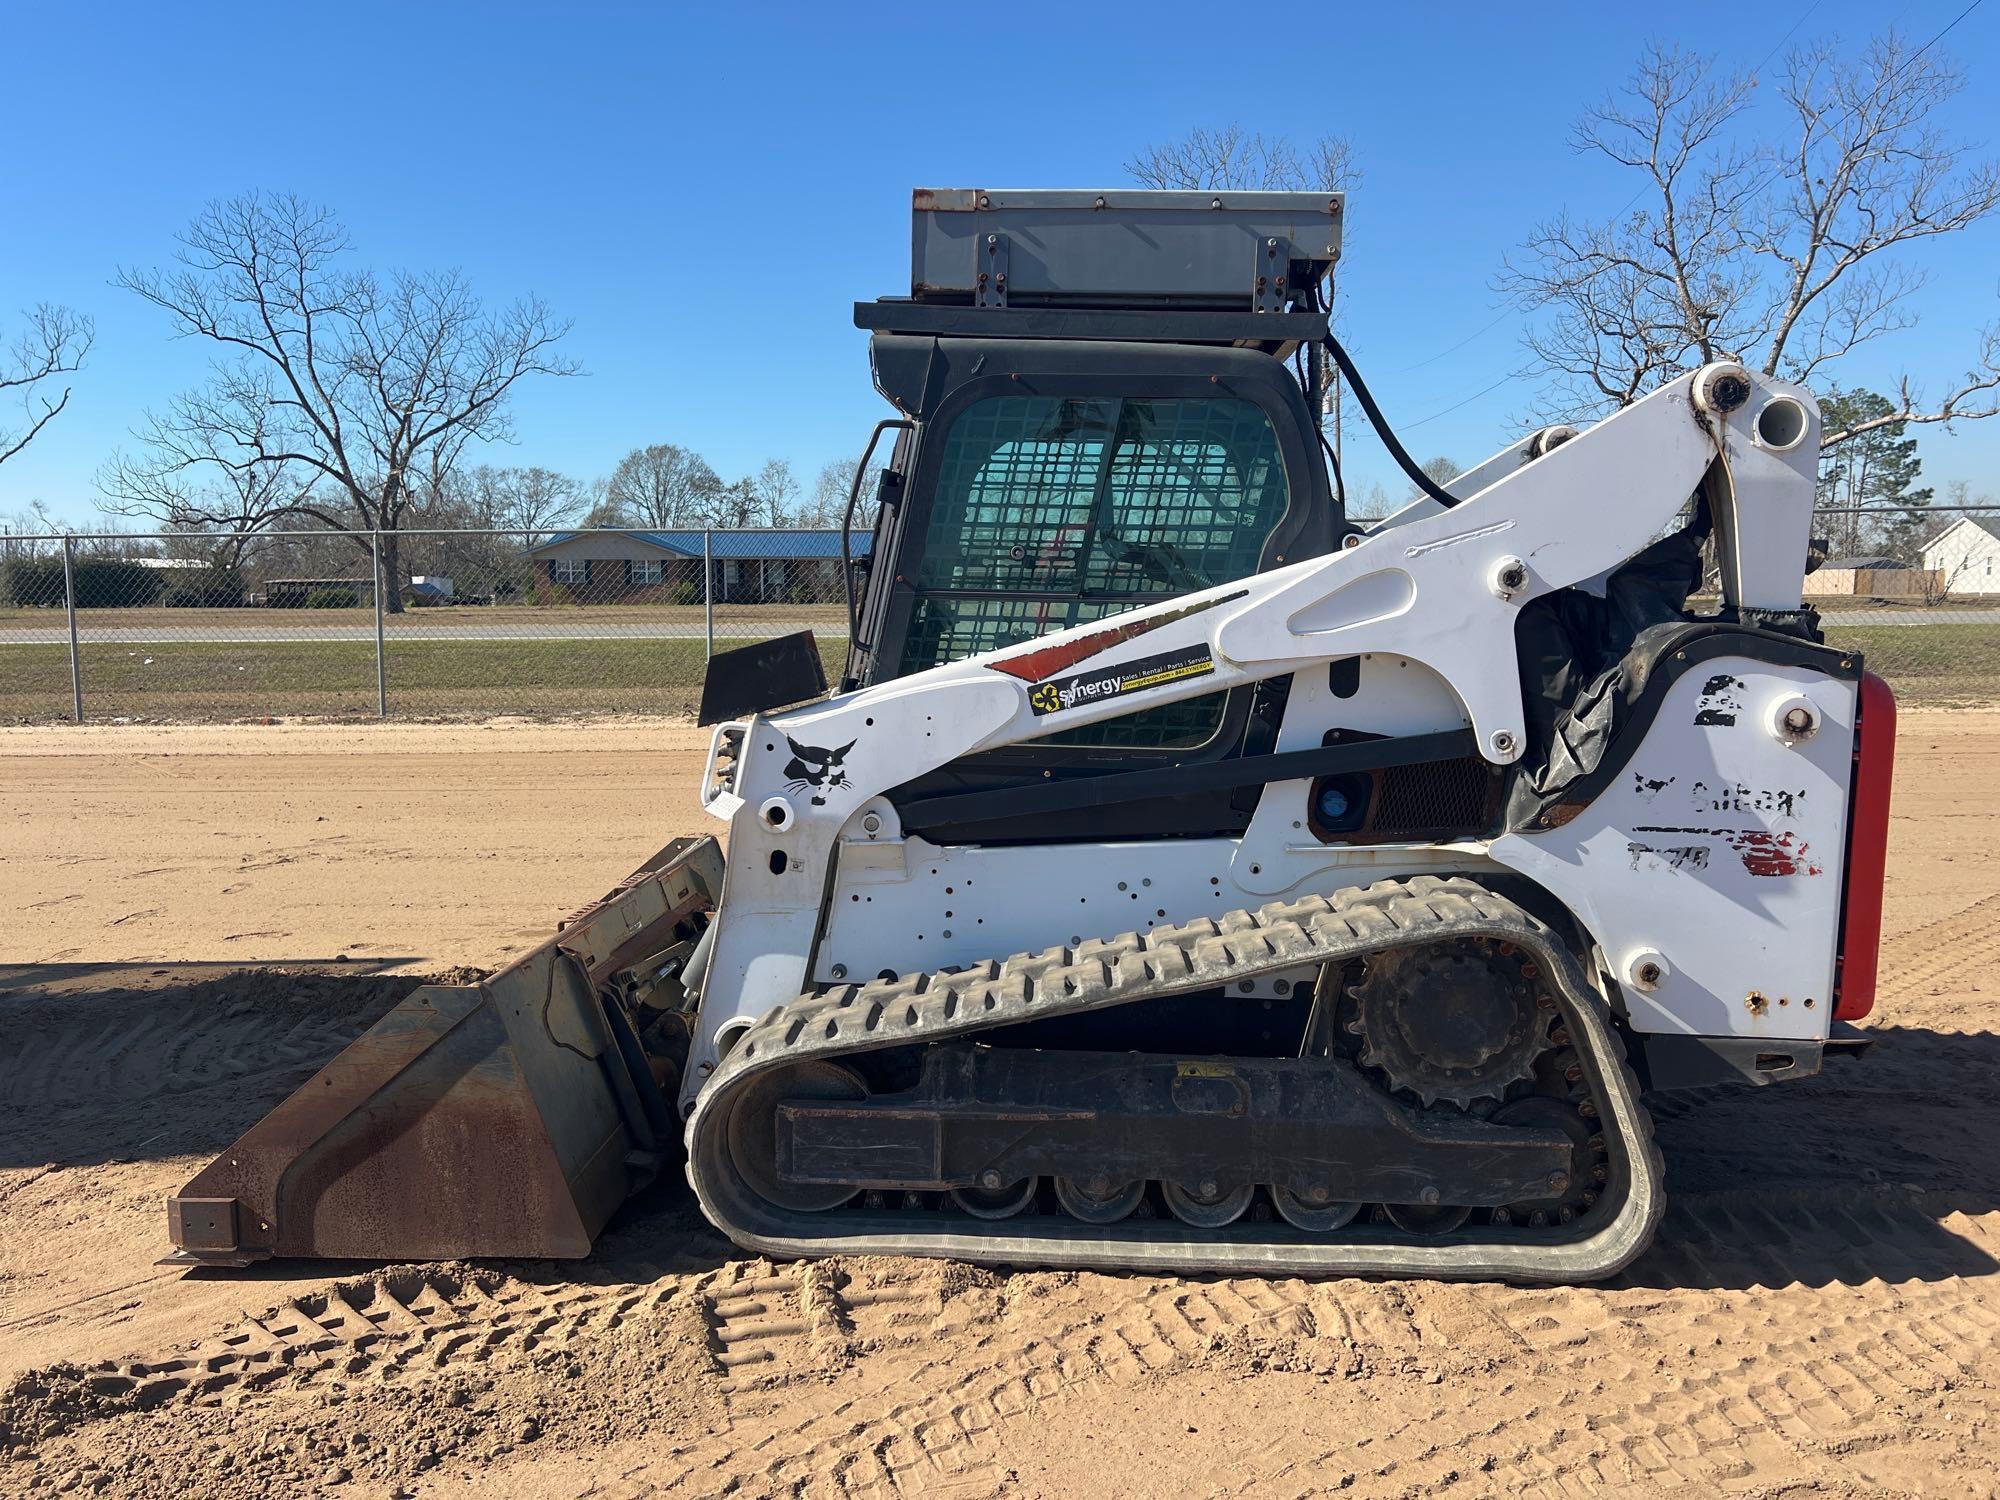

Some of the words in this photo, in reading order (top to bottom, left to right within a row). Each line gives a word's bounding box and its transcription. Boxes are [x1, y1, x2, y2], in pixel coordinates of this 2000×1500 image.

[1122, 673, 1138, 682] Sales
[1142, 666, 1163, 677] Rental
[1167, 661, 1184, 670] Parts
[1187, 655, 1211, 666] Service
[1122, 673, 1171, 689] SynergyEquip.com
[1059, 677, 1121, 706] synergy
